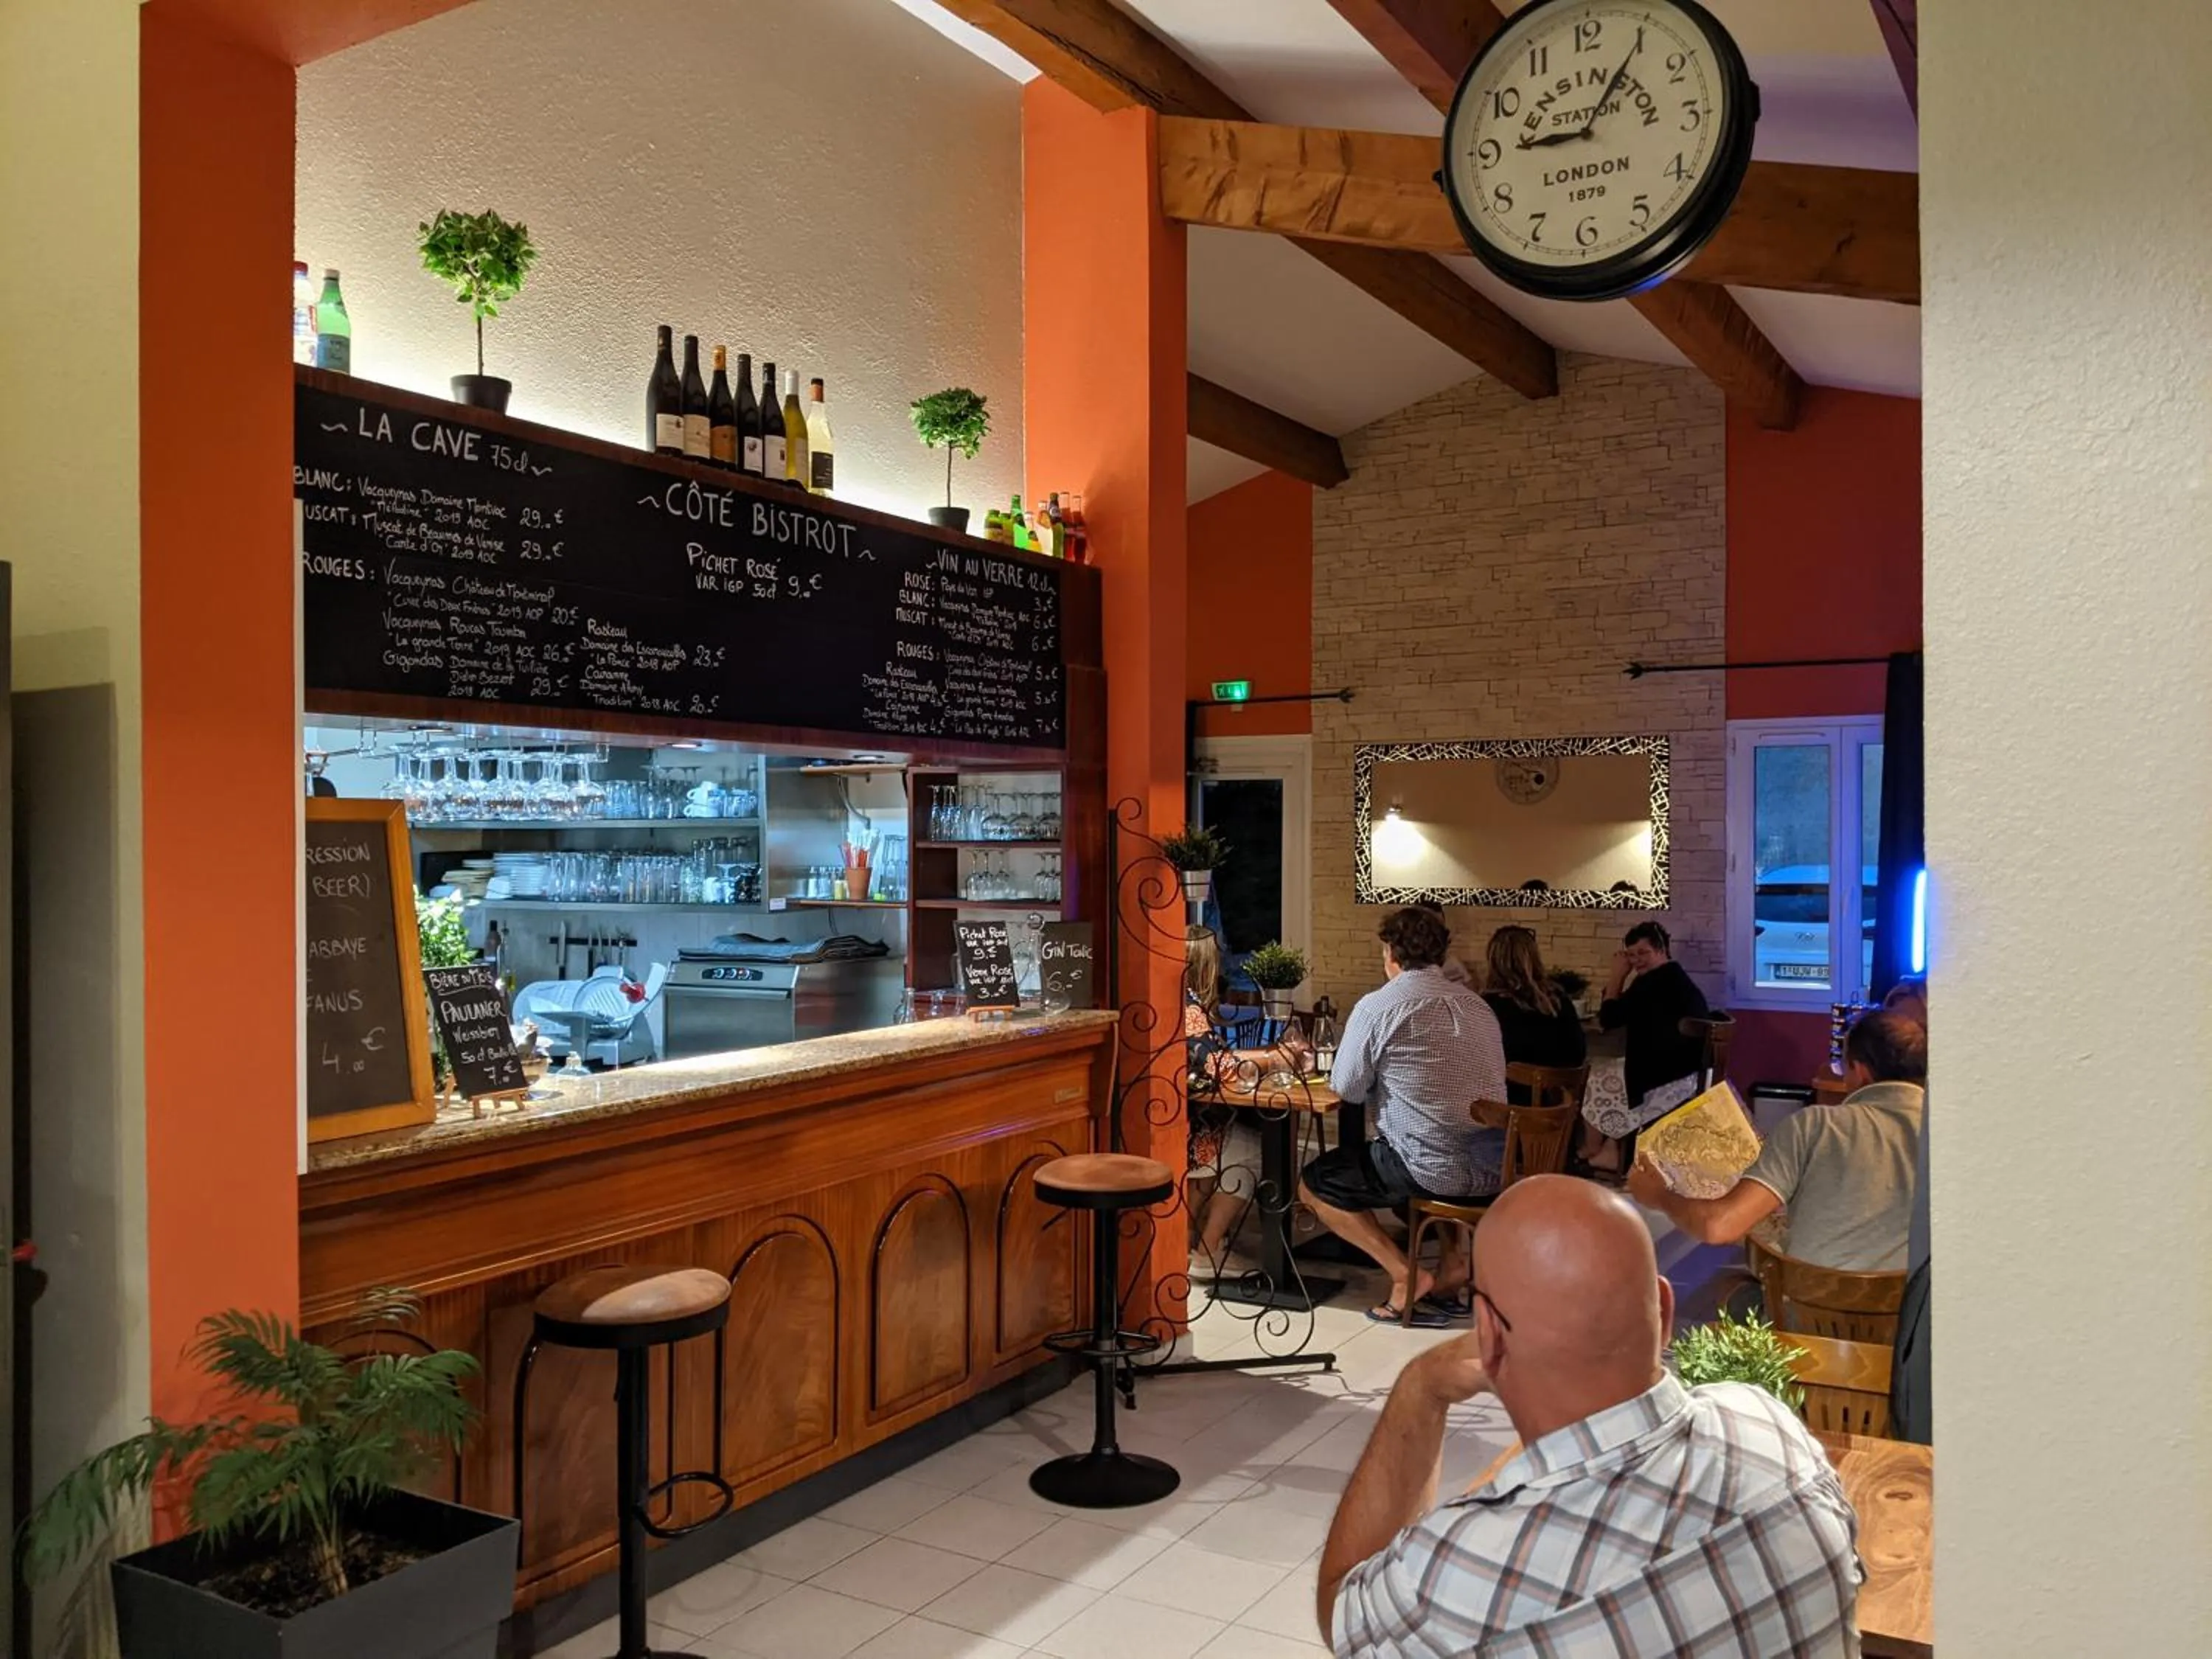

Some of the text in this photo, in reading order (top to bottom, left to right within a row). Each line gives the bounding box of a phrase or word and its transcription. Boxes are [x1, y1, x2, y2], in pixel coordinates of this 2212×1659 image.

[1573, 20, 1601, 54] 12
[1528, 46, 1548, 77] 11
[1666, 52, 1686, 85] 2
[1492, 86, 1521, 120] 10
[1517, 67, 1660, 151] KENSINGTON
[1551, 100, 1621, 127] STATION
[1680, 100, 1700, 132] 3
[1478, 139, 1502, 170] 9
[1663, 152, 1688, 183] 4
[1543, 156, 1630, 187] LONDON
[1492, 182, 1514, 214] 8
[1568, 185, 1607, 204] 1879
[1629, 195, 1651, 227] 5
[1528, 212, 1546, 243] 7
[1575, 216, 1599, 246] 6
[358, 407, 394, 443] LA
[411, 422, 481, 461] CAVE
[665, 480, 734, 528] CÔTÉ
[695, 572, 719, 591] VAR
[937, 549, 959, 574] VIN
[965, 558, 979, 576] AU
[981, 557, 1024, 589] VERRE
[440, 1001, 509, 1024] PAULANER
